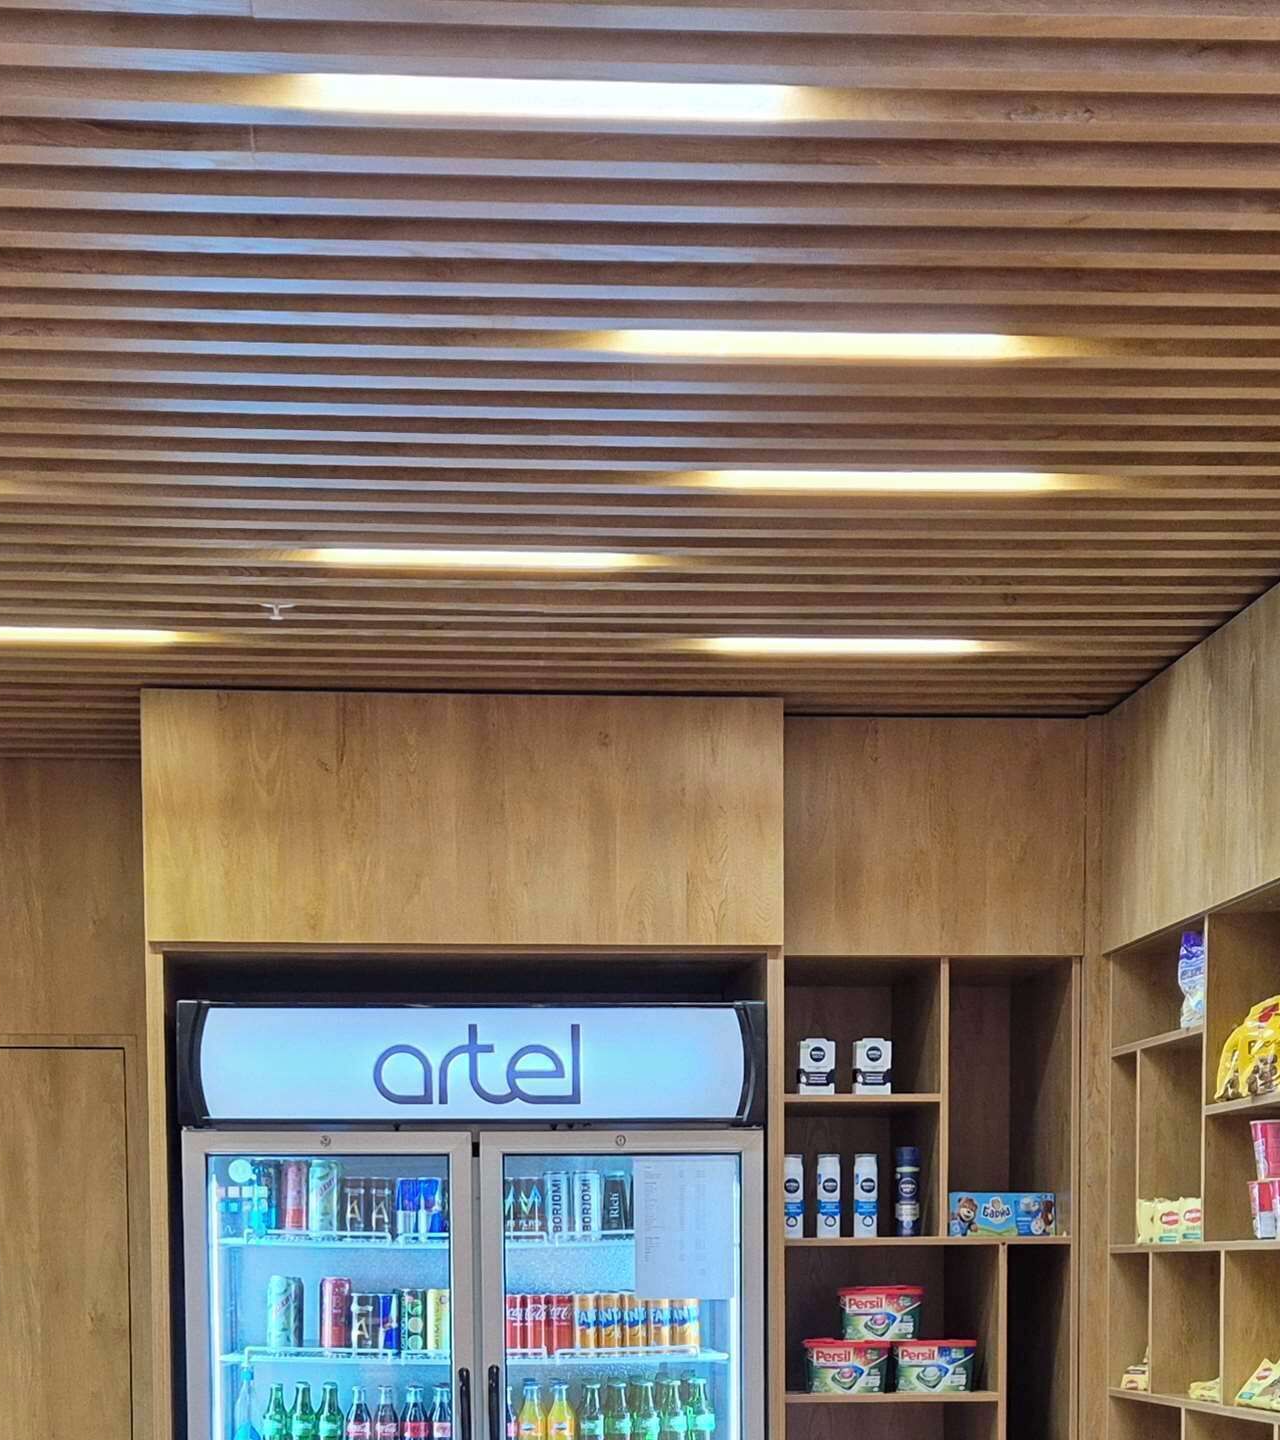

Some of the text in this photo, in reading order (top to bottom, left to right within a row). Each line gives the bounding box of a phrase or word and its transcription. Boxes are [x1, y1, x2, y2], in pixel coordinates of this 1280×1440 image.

[373, 1023, 582, 1105] artel
[552, 1180, 562, 1233] BORJOMI
[582, 1179, 592, 1231] BORJOMI
[609, 1193, 620, 1218] Rich
[848, 1298, 883, 1309] Persil
[816, 1350, 851, 1362] Persil
[901, 1349, 935, 1361] Persil
